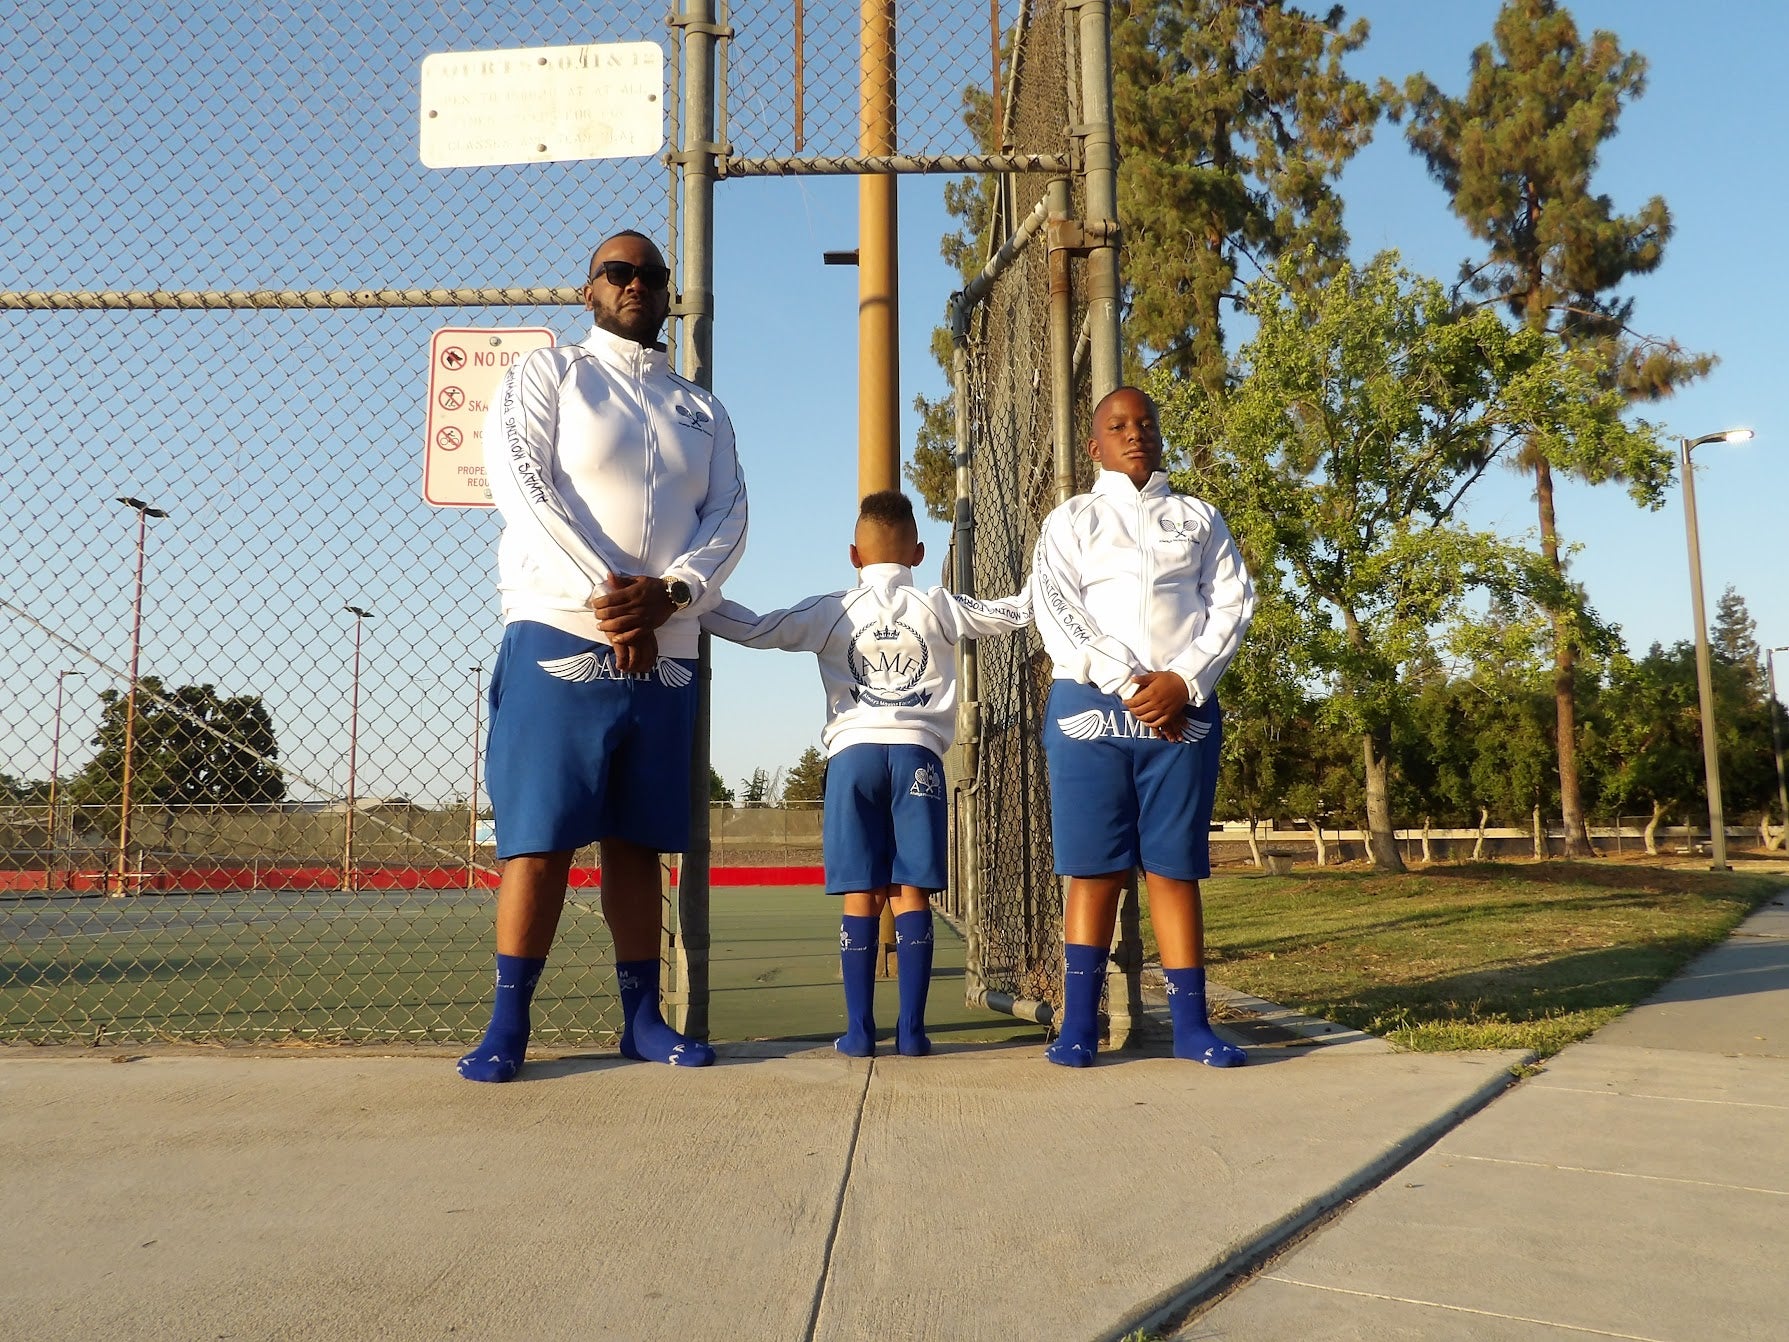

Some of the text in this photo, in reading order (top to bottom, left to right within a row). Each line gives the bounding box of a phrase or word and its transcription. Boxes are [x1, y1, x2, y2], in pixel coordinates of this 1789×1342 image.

[474, 351, 495, 367] NO
[505, 417, 526, 461] MOVING
[518, 462, 549, 505] ALWAYS
[861, 651, 920, 677] AMF
